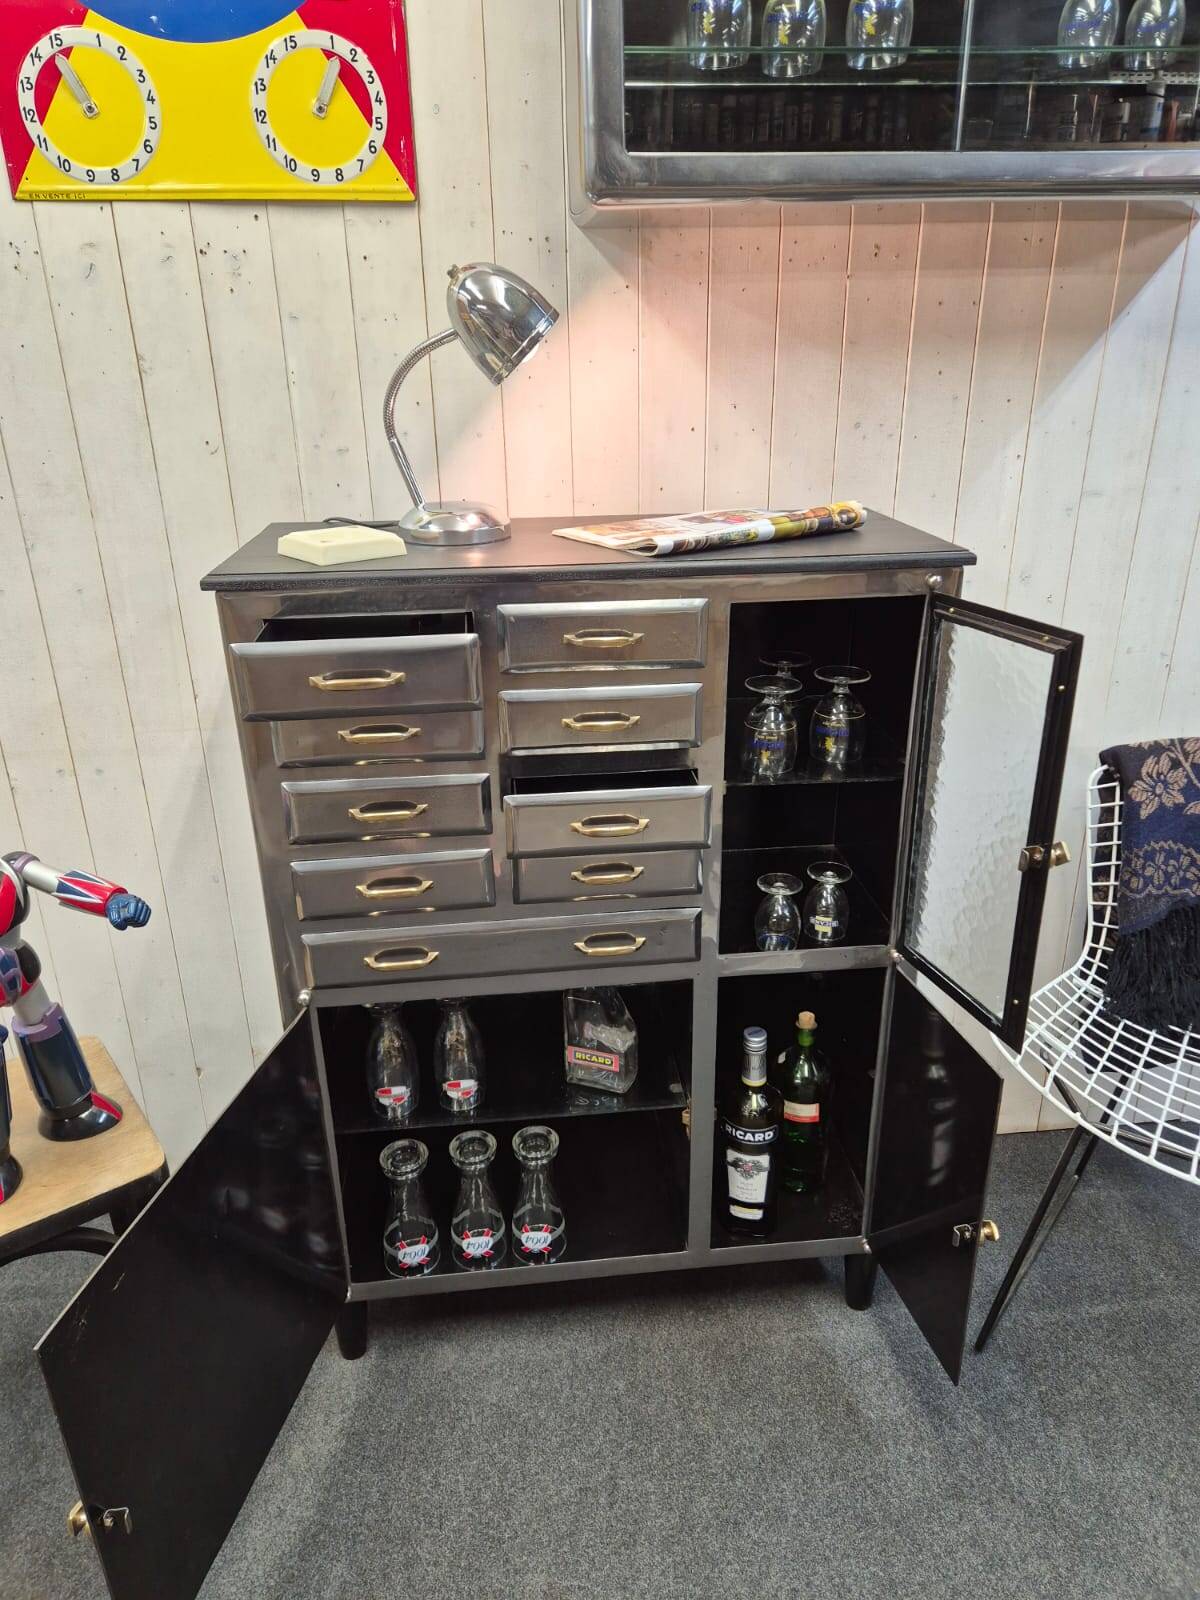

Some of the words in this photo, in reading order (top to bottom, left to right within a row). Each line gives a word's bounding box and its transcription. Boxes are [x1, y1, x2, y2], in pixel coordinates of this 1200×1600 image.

[48, 33, 64, 49] 15
[95, 33, 102, 48] 1
[283, 35, 298, 52] 15
[329, 35, 335, 50] 1
[29, 46, 43, 67] 14
[117, 45, 128, 61] 2
[264, 49, 278, 69] 14
[349, 47, 358, 63] 2
[19, 76, 34, 93] 13
[136, 69, 146, 84] 3
[366, 70, 375, 85] 3
[254, 77, 267, 95] 13
[146, 89, 156, 105] 4
[374, 90, 384, 106] 4
[22, 106, 37, 123] 12
[254, 107, 268, 125] 12
[148, 116, 158, 131] 5
[374, 116, 384, 131] 5
[36, 133, 49, 152] 11
[143, 138, 154, 154] 6
[265, 134, 277, 152] 11
[368, 139, 378, 155] 6
[57, 155, 72, 173] 10
[131, 158, 140, 172] 7
[283, 154, 298, 173] 10
[356, 158, 364, 173] 7
[85, 169, 96, 183] 9
[110, 167, 121, 183] 8
[310, 168, 321, 183] 9
[335, 167, 345, 182] 8
[575, 1051, 612, 1065] RICARD
[725, 1123, 774, 1142] RICARD
